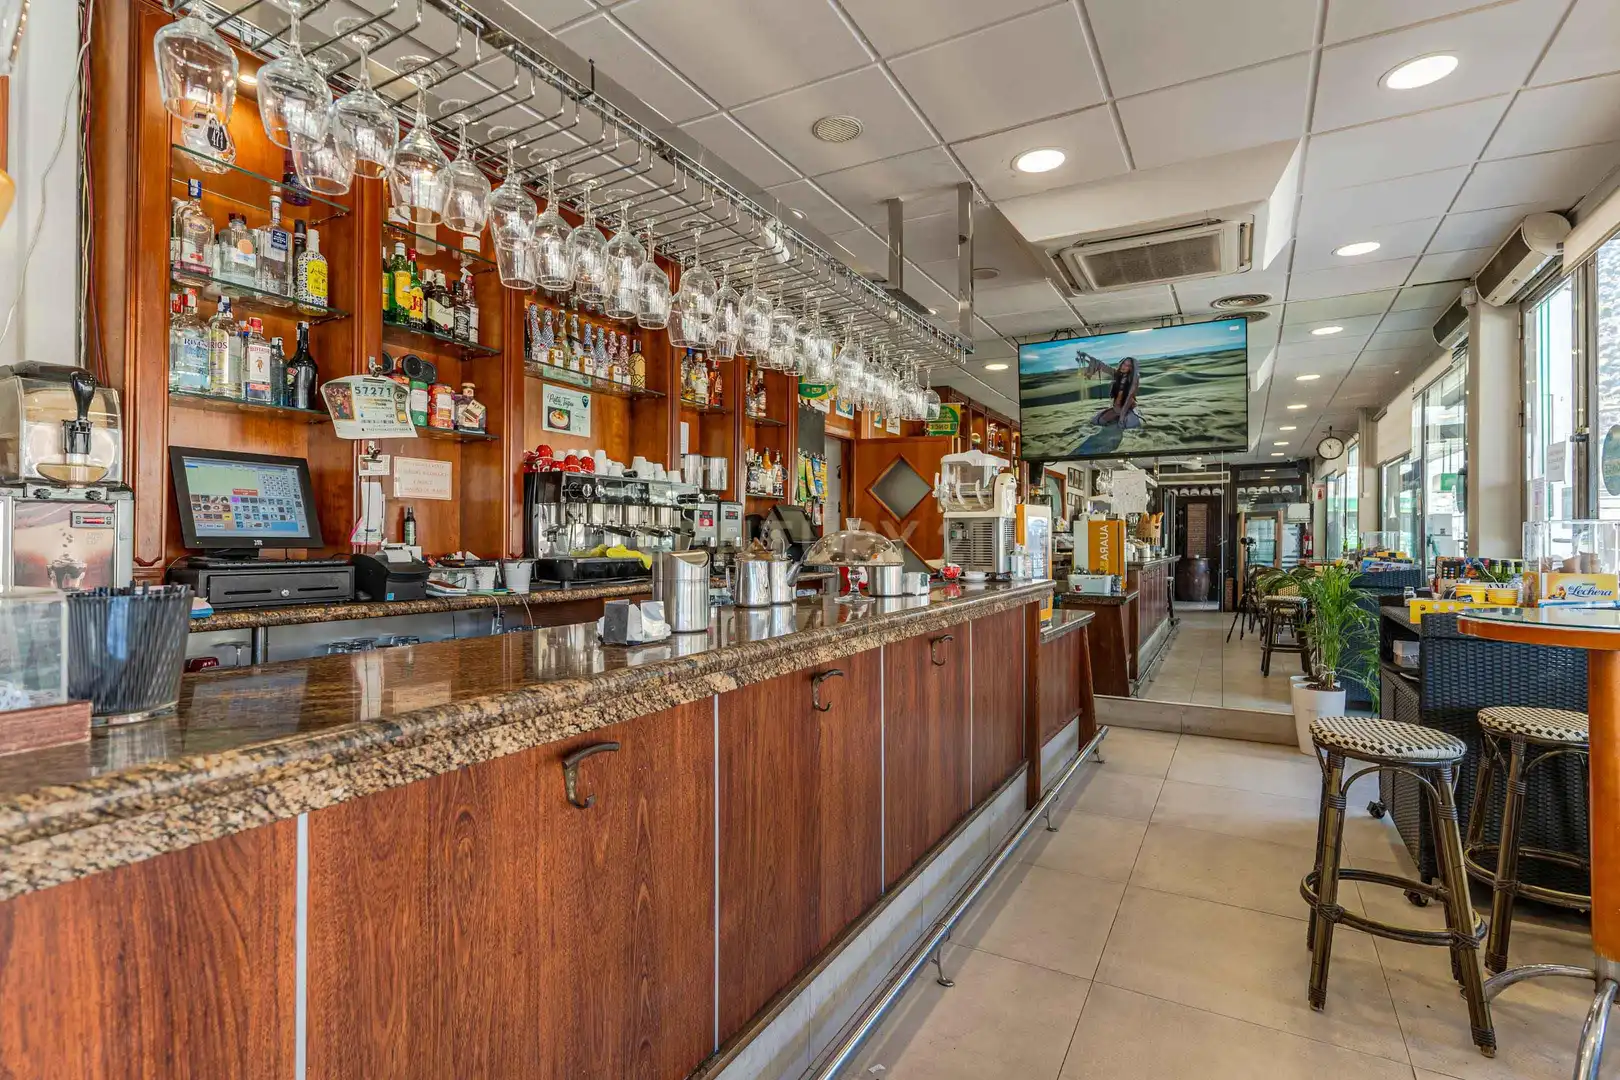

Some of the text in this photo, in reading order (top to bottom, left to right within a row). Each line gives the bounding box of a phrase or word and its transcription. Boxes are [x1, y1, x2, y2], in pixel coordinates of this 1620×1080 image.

[210, 341, 228, 349] RIOS
[354, 386, 392, 396] 57271
[1573, 585, 1613, 598] Lechera
